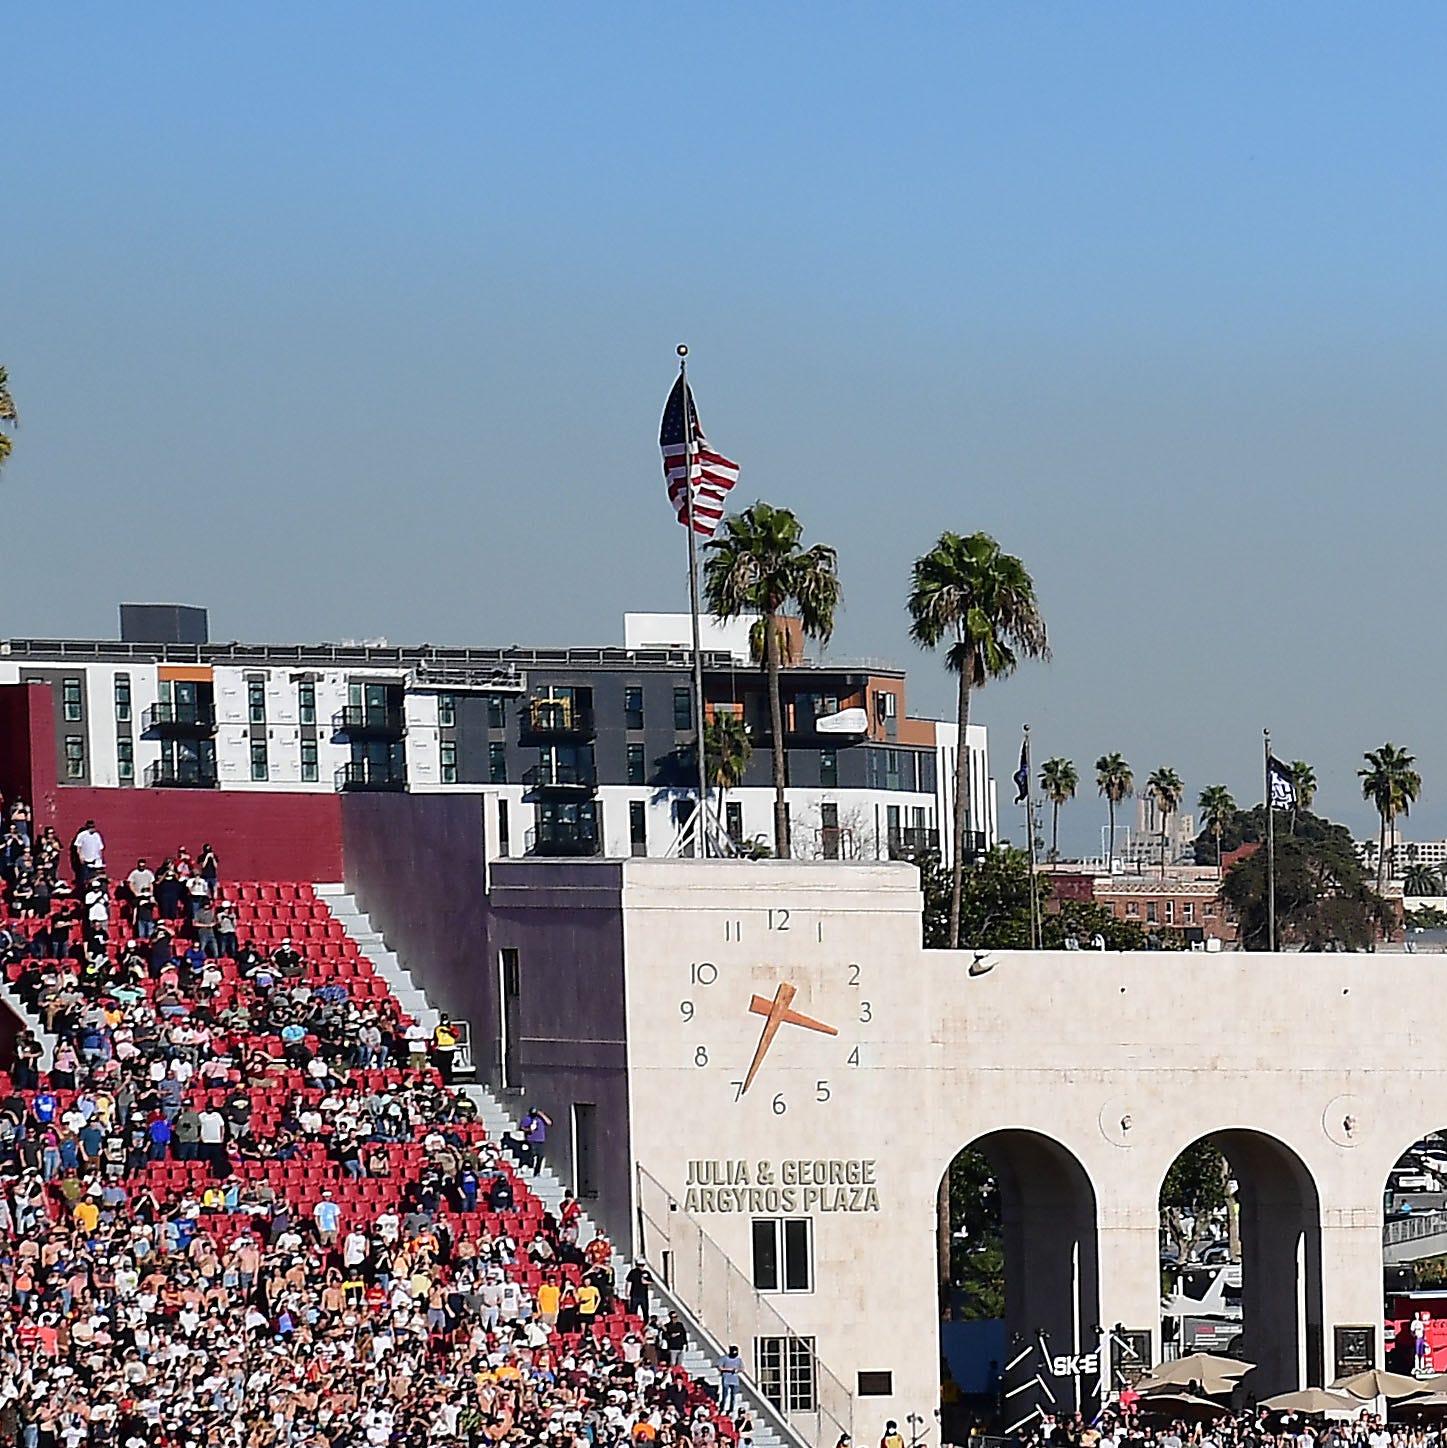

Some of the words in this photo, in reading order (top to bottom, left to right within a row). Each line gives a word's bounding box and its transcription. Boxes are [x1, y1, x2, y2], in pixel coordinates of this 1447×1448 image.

[725, 920, 741, 943] 11
[767, 908, 791, 932] 12
[690, 962, 719, 986] 10
[848, 964, 861, 986] 2
[680, 1000, 695, 1023] 9
[859, 1001, 873, 1023] 3
[694, 1045, 709, 1067] 8
[847, 1046, 860, 1067] 4
[815, 1080, 831, 1102] 5
[772, 1092, 787, 1115] 6
[685, 1159, 751, 1186] JULIA
[756, 1159, 774, 1186] &
[781, 1158, 877, 1185] GEORGE
[684, 1187, 798, 1213] ARGYROS
[803, 1187, 880, 1213] PLAZA
